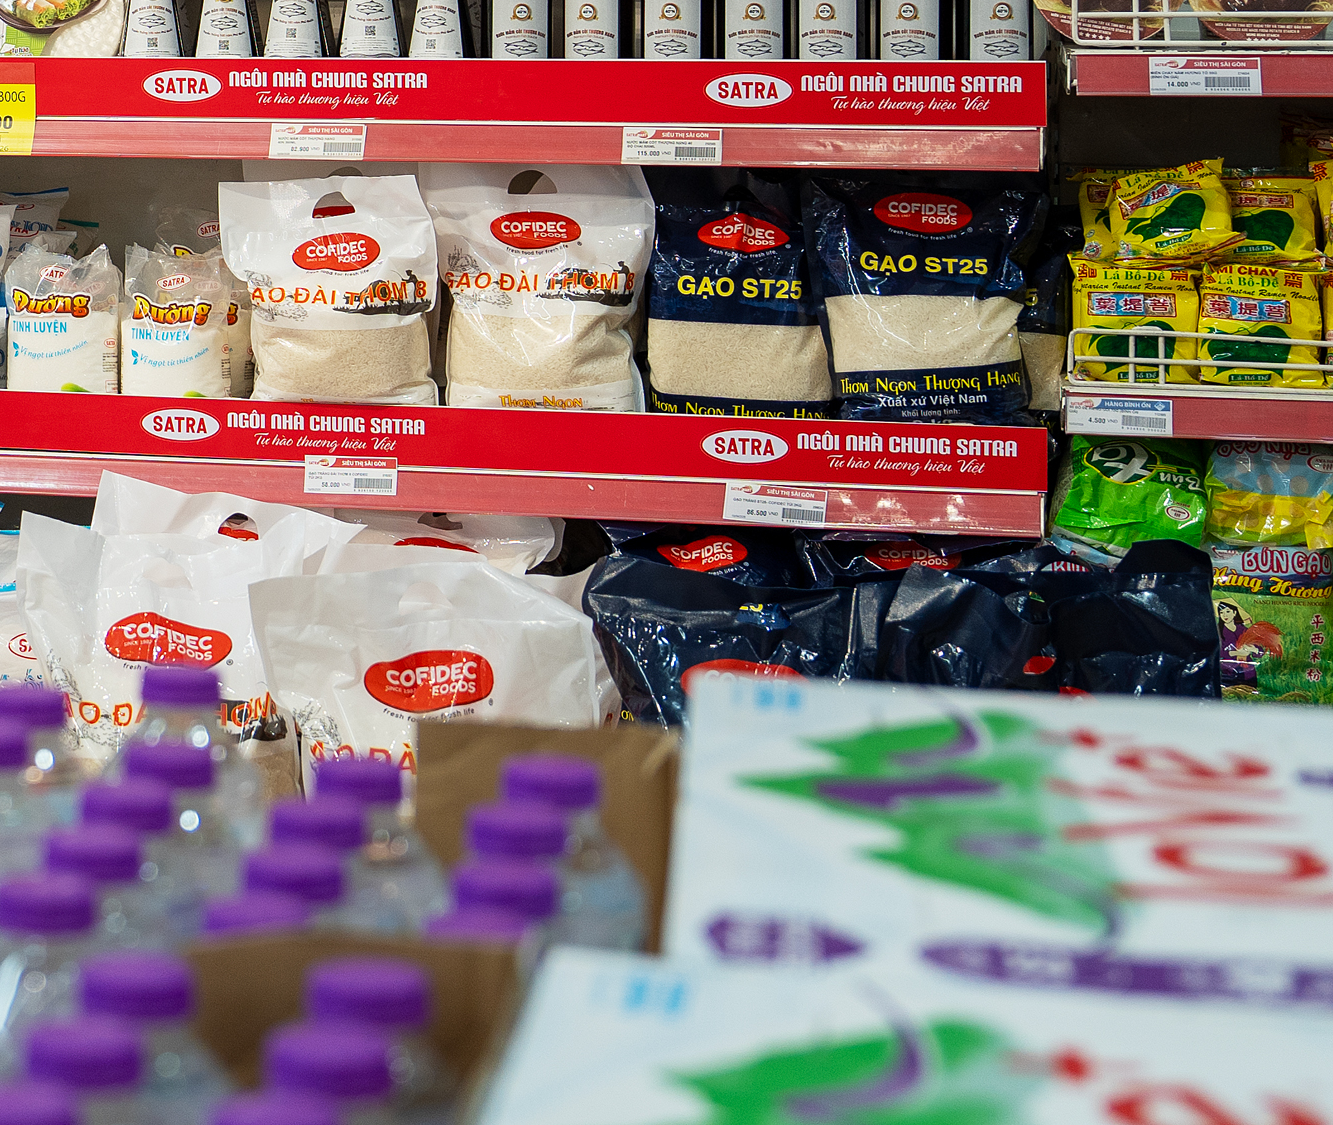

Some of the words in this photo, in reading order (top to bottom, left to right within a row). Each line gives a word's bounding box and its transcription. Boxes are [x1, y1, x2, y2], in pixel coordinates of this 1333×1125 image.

[888, 200, 958, 218] COFIDEC
[922, 215, 958, 226] FOODS
[860, 251, 918, 276] GẠO
[925, 256, 988, 276] ST25
[878, 395, 907, 410] Xuất
[911, 393, 927, 407] xứ
[929, 392, 955, 408] Việt
[959, 392, 987, 405] Nam
[714, 437, 775, 457] SATRA
[797, 430, 841, 451] NGÔI
[846, 432, 883, 452] NHÀ
[889, 436, 950, 455] CHUNG
[956, 439, 1018, 457] SATRA
[1242, 547, 1288, 573] BÚN
[1270, 576, 1332, 599] Hương
